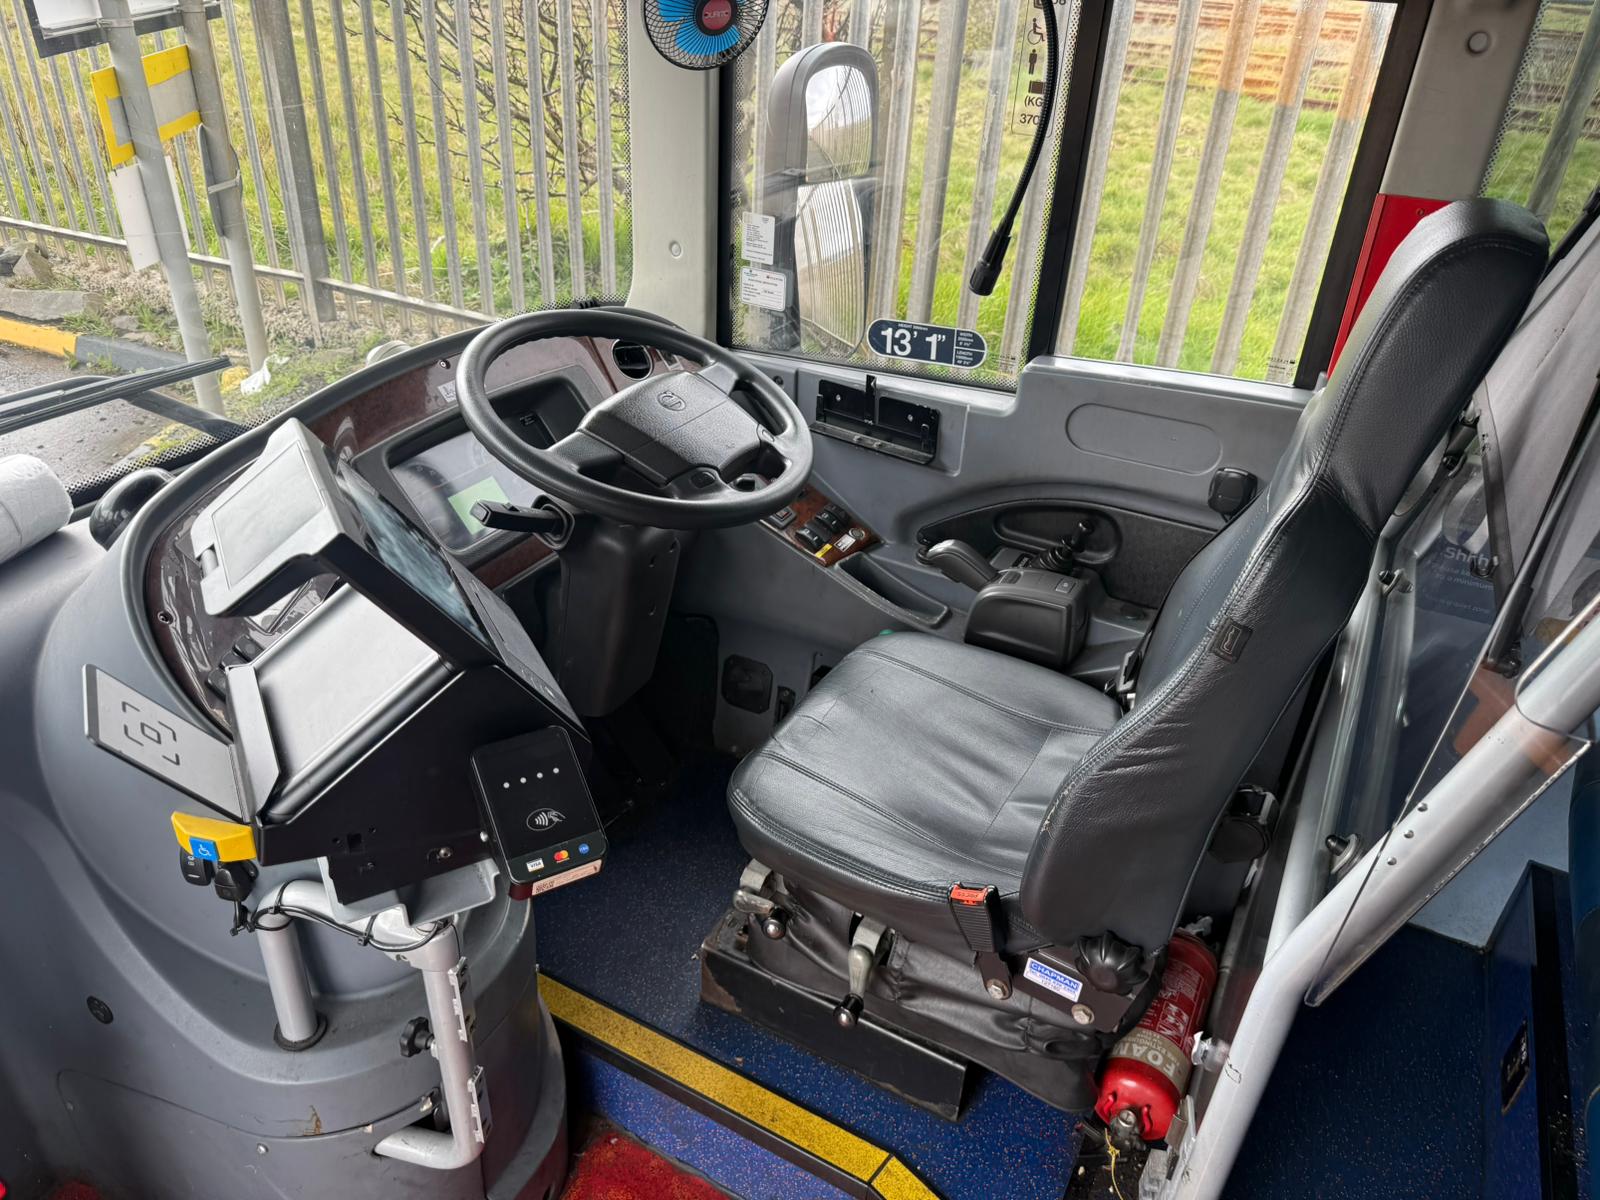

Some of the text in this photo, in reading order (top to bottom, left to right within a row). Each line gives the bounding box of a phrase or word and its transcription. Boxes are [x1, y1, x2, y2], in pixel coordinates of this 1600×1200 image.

[881, 327, 946, 360] 13' 1"
[1031, 962, 1078, 989] CHAPMAN
[1114, 1040, 1177, 1077] FOAM
